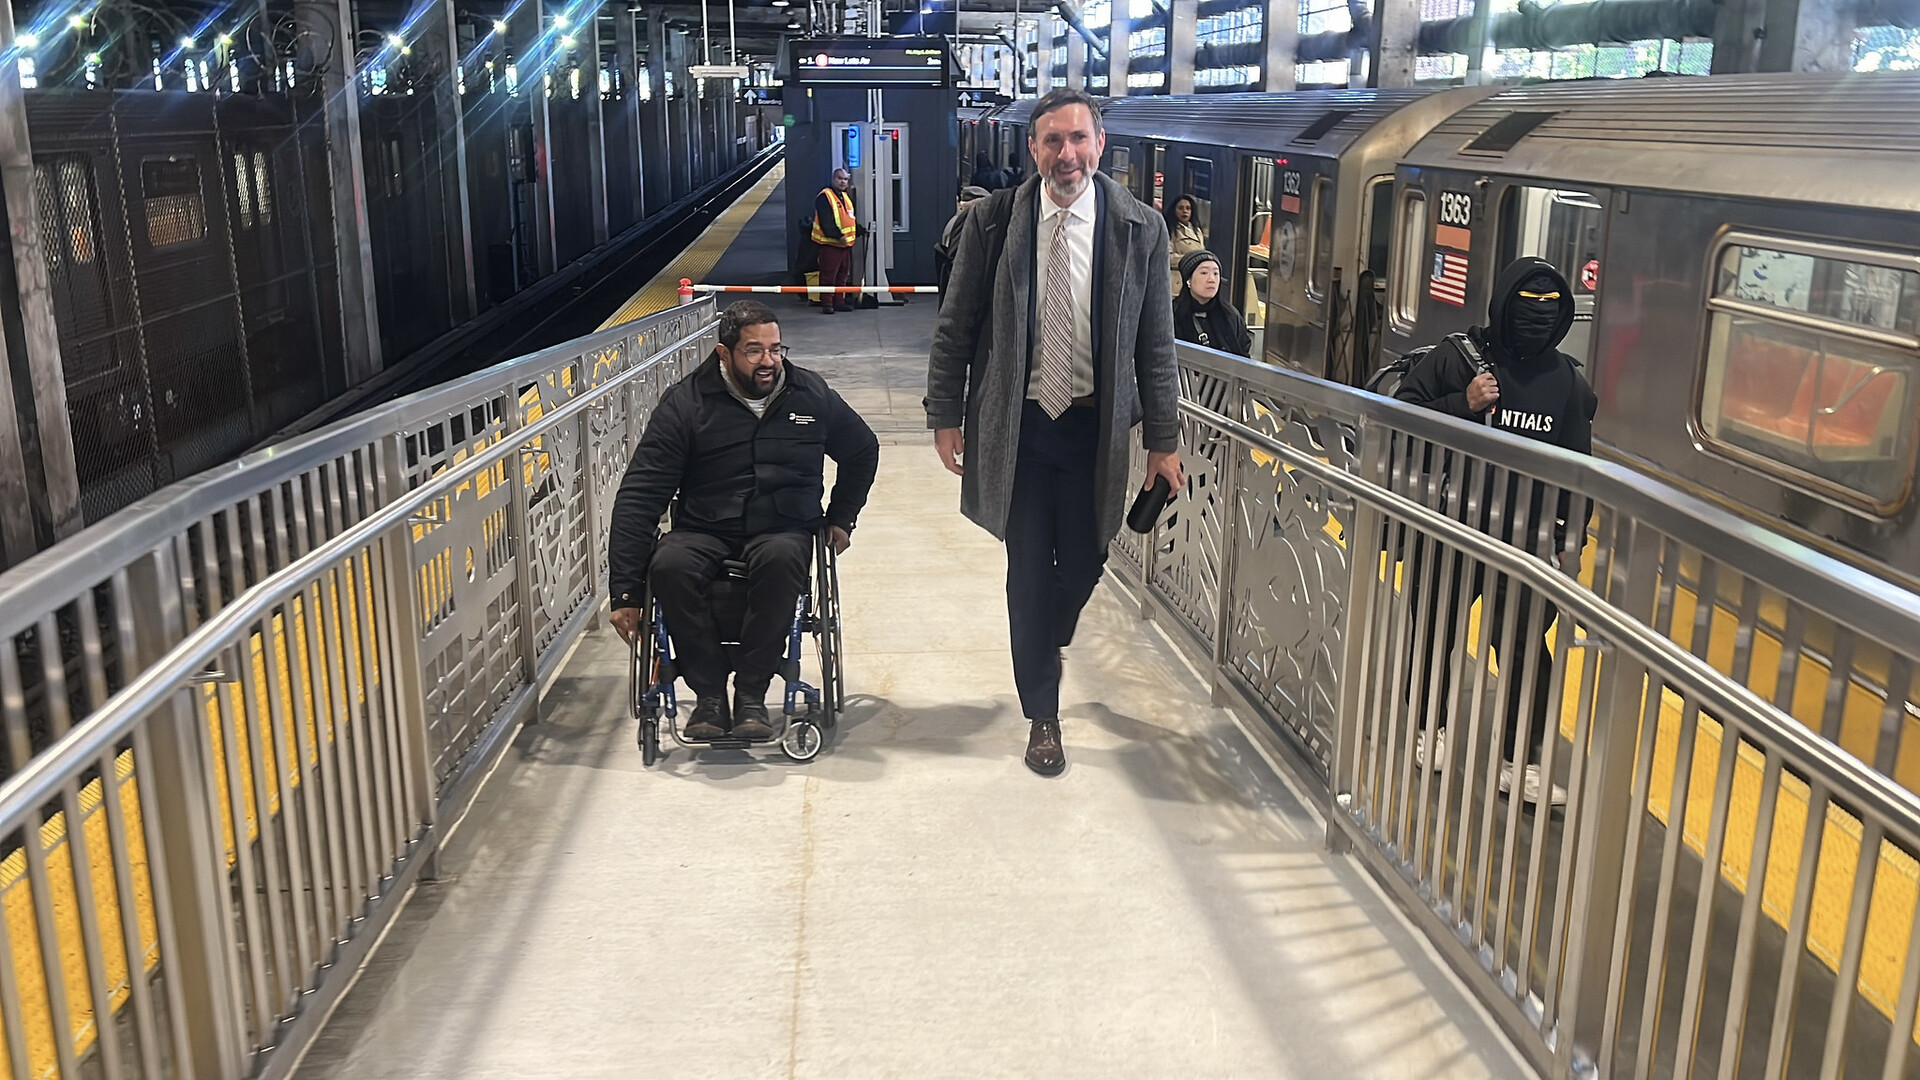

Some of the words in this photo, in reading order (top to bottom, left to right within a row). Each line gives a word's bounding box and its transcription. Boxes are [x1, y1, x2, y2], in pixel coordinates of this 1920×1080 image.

[1283, 171, 1301, 195] 1362
[1440, 191, 1471, 226] 1363
[1499, 408, 1554, 432] NTIALS
